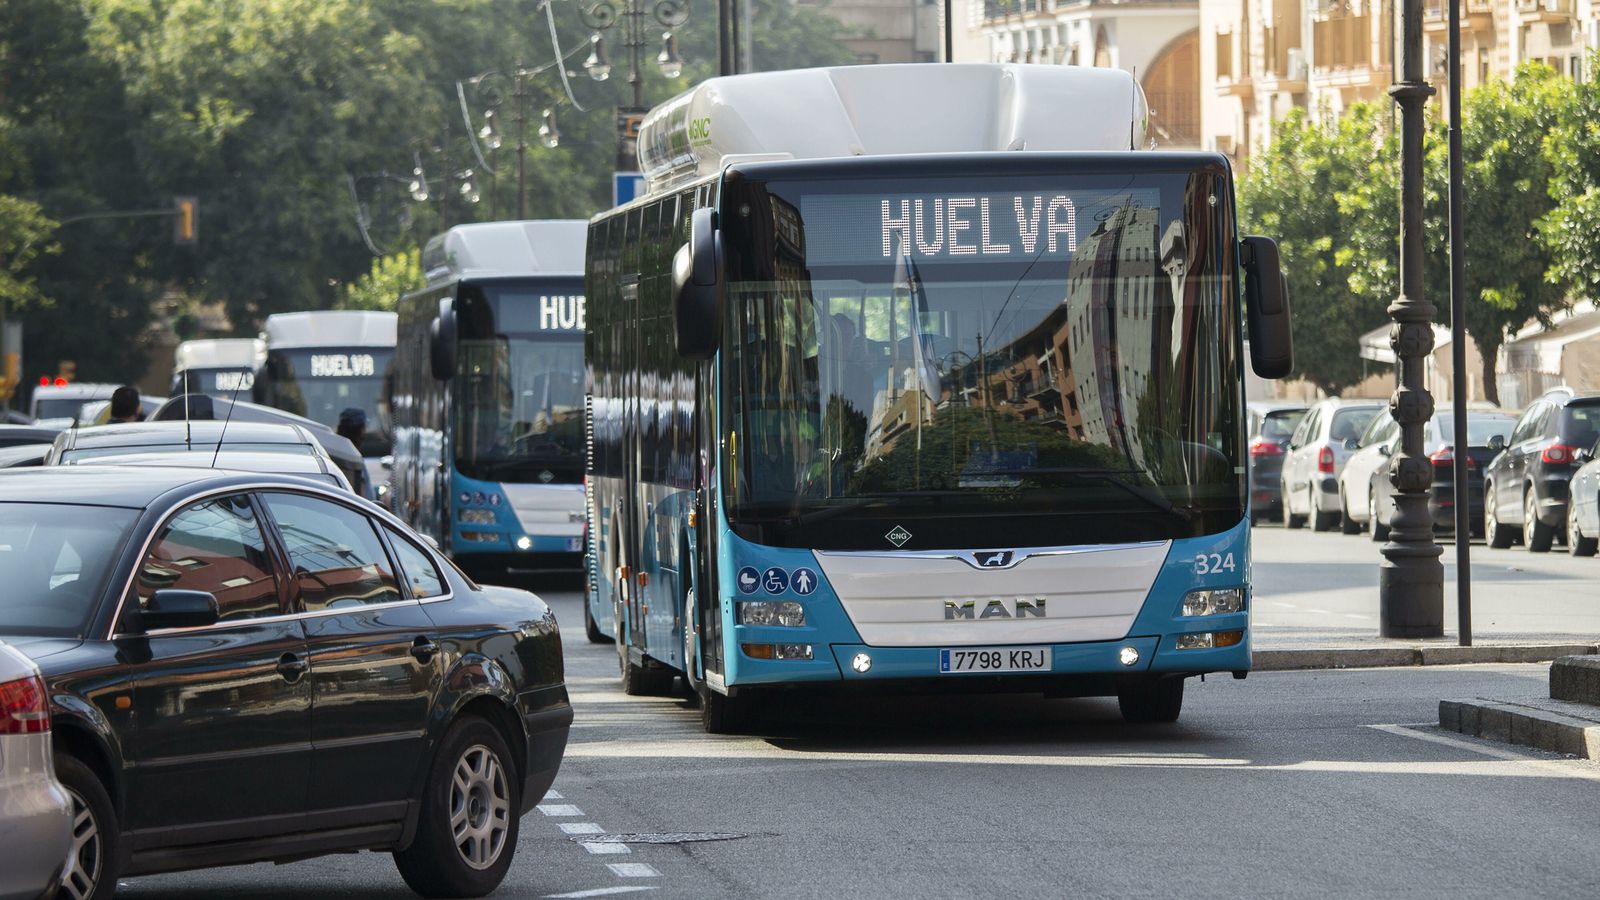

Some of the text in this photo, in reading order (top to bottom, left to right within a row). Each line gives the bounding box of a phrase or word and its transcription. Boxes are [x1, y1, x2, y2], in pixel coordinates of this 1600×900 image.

[881, 195, 1077, 257] HUELVA
[540, 295, 586, 330] HUE
[311, 354, 374, 377] HUELVA
[890, 532, 907, 540] CNG
[1195, 552, 1236, 575] 324
[944, 597, 1046, 619] MAN
[955, 649, 1045, 670] 7798 KRJ
